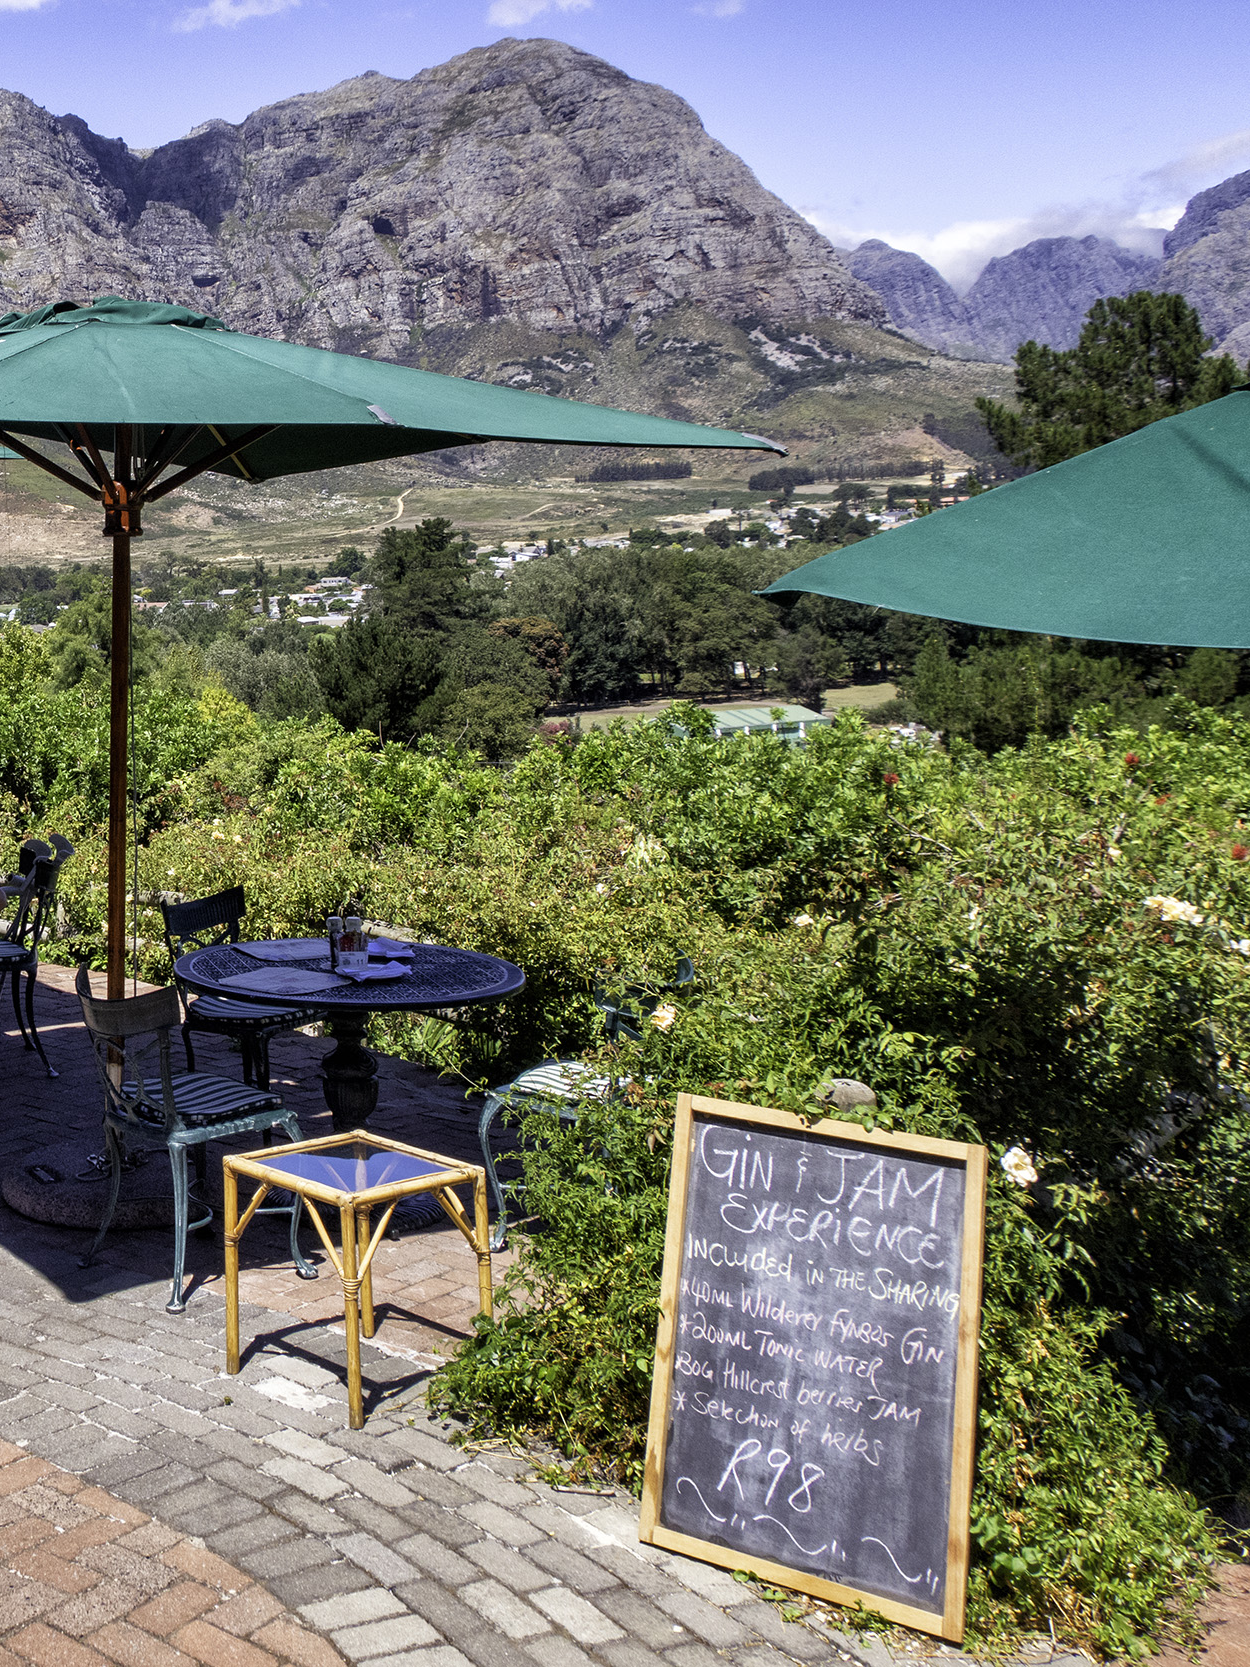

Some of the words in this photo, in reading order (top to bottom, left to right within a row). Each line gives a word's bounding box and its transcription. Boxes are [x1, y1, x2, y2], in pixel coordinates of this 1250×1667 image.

[817, 1149, 945, 1228] JAM
[720, 1193, 945, 1269] EXPERIENCE
[829, 1267, 866, 1291] THE
[868, 1267, 960, 1324] SHARING
[723, 1358, 790, 1400] Hillcrest
[797, 1380, 863, 1413] berries
[867, 1395, 922, 1428] JAM
[814, 1348, 884, 1396] WATER
[717, 1439, 826, 1513] R98
[790, 1418, 811, 1444] of
[821, 1422, 884, 1467] herbs
